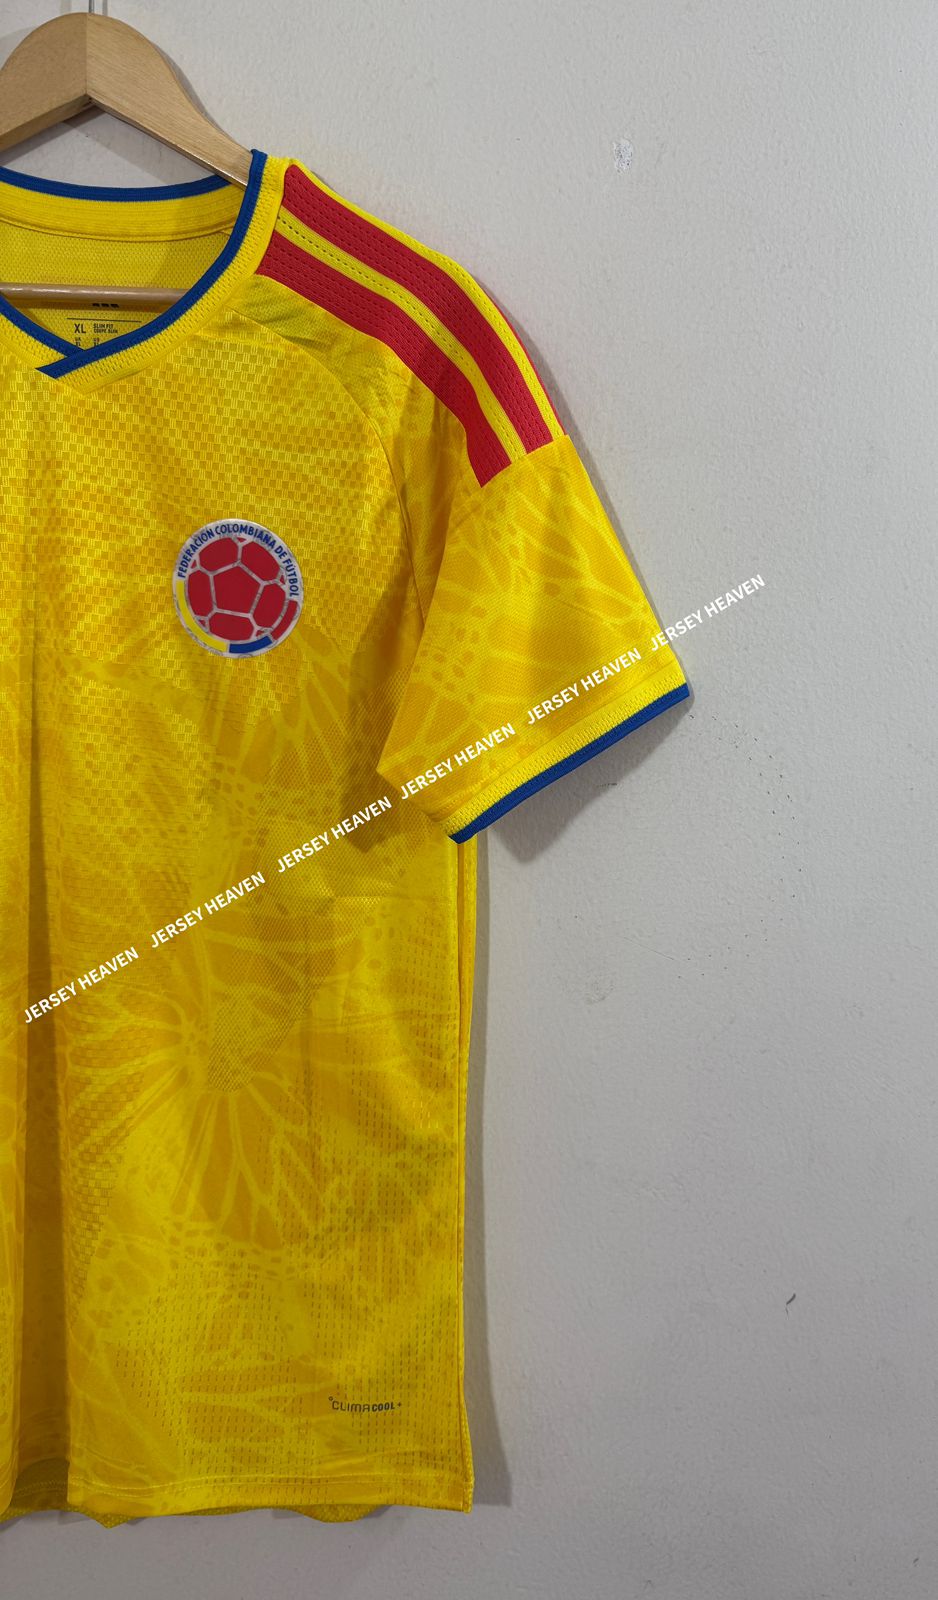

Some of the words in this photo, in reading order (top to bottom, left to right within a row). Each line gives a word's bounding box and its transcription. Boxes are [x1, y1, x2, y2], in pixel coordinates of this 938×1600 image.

[74, 323, 87, 334] XL
[215, 523, 277, 548] COLOMBIANA
[274, 546, 287, 559] DE
[283, 559, 299, 597] FÚTBOL
